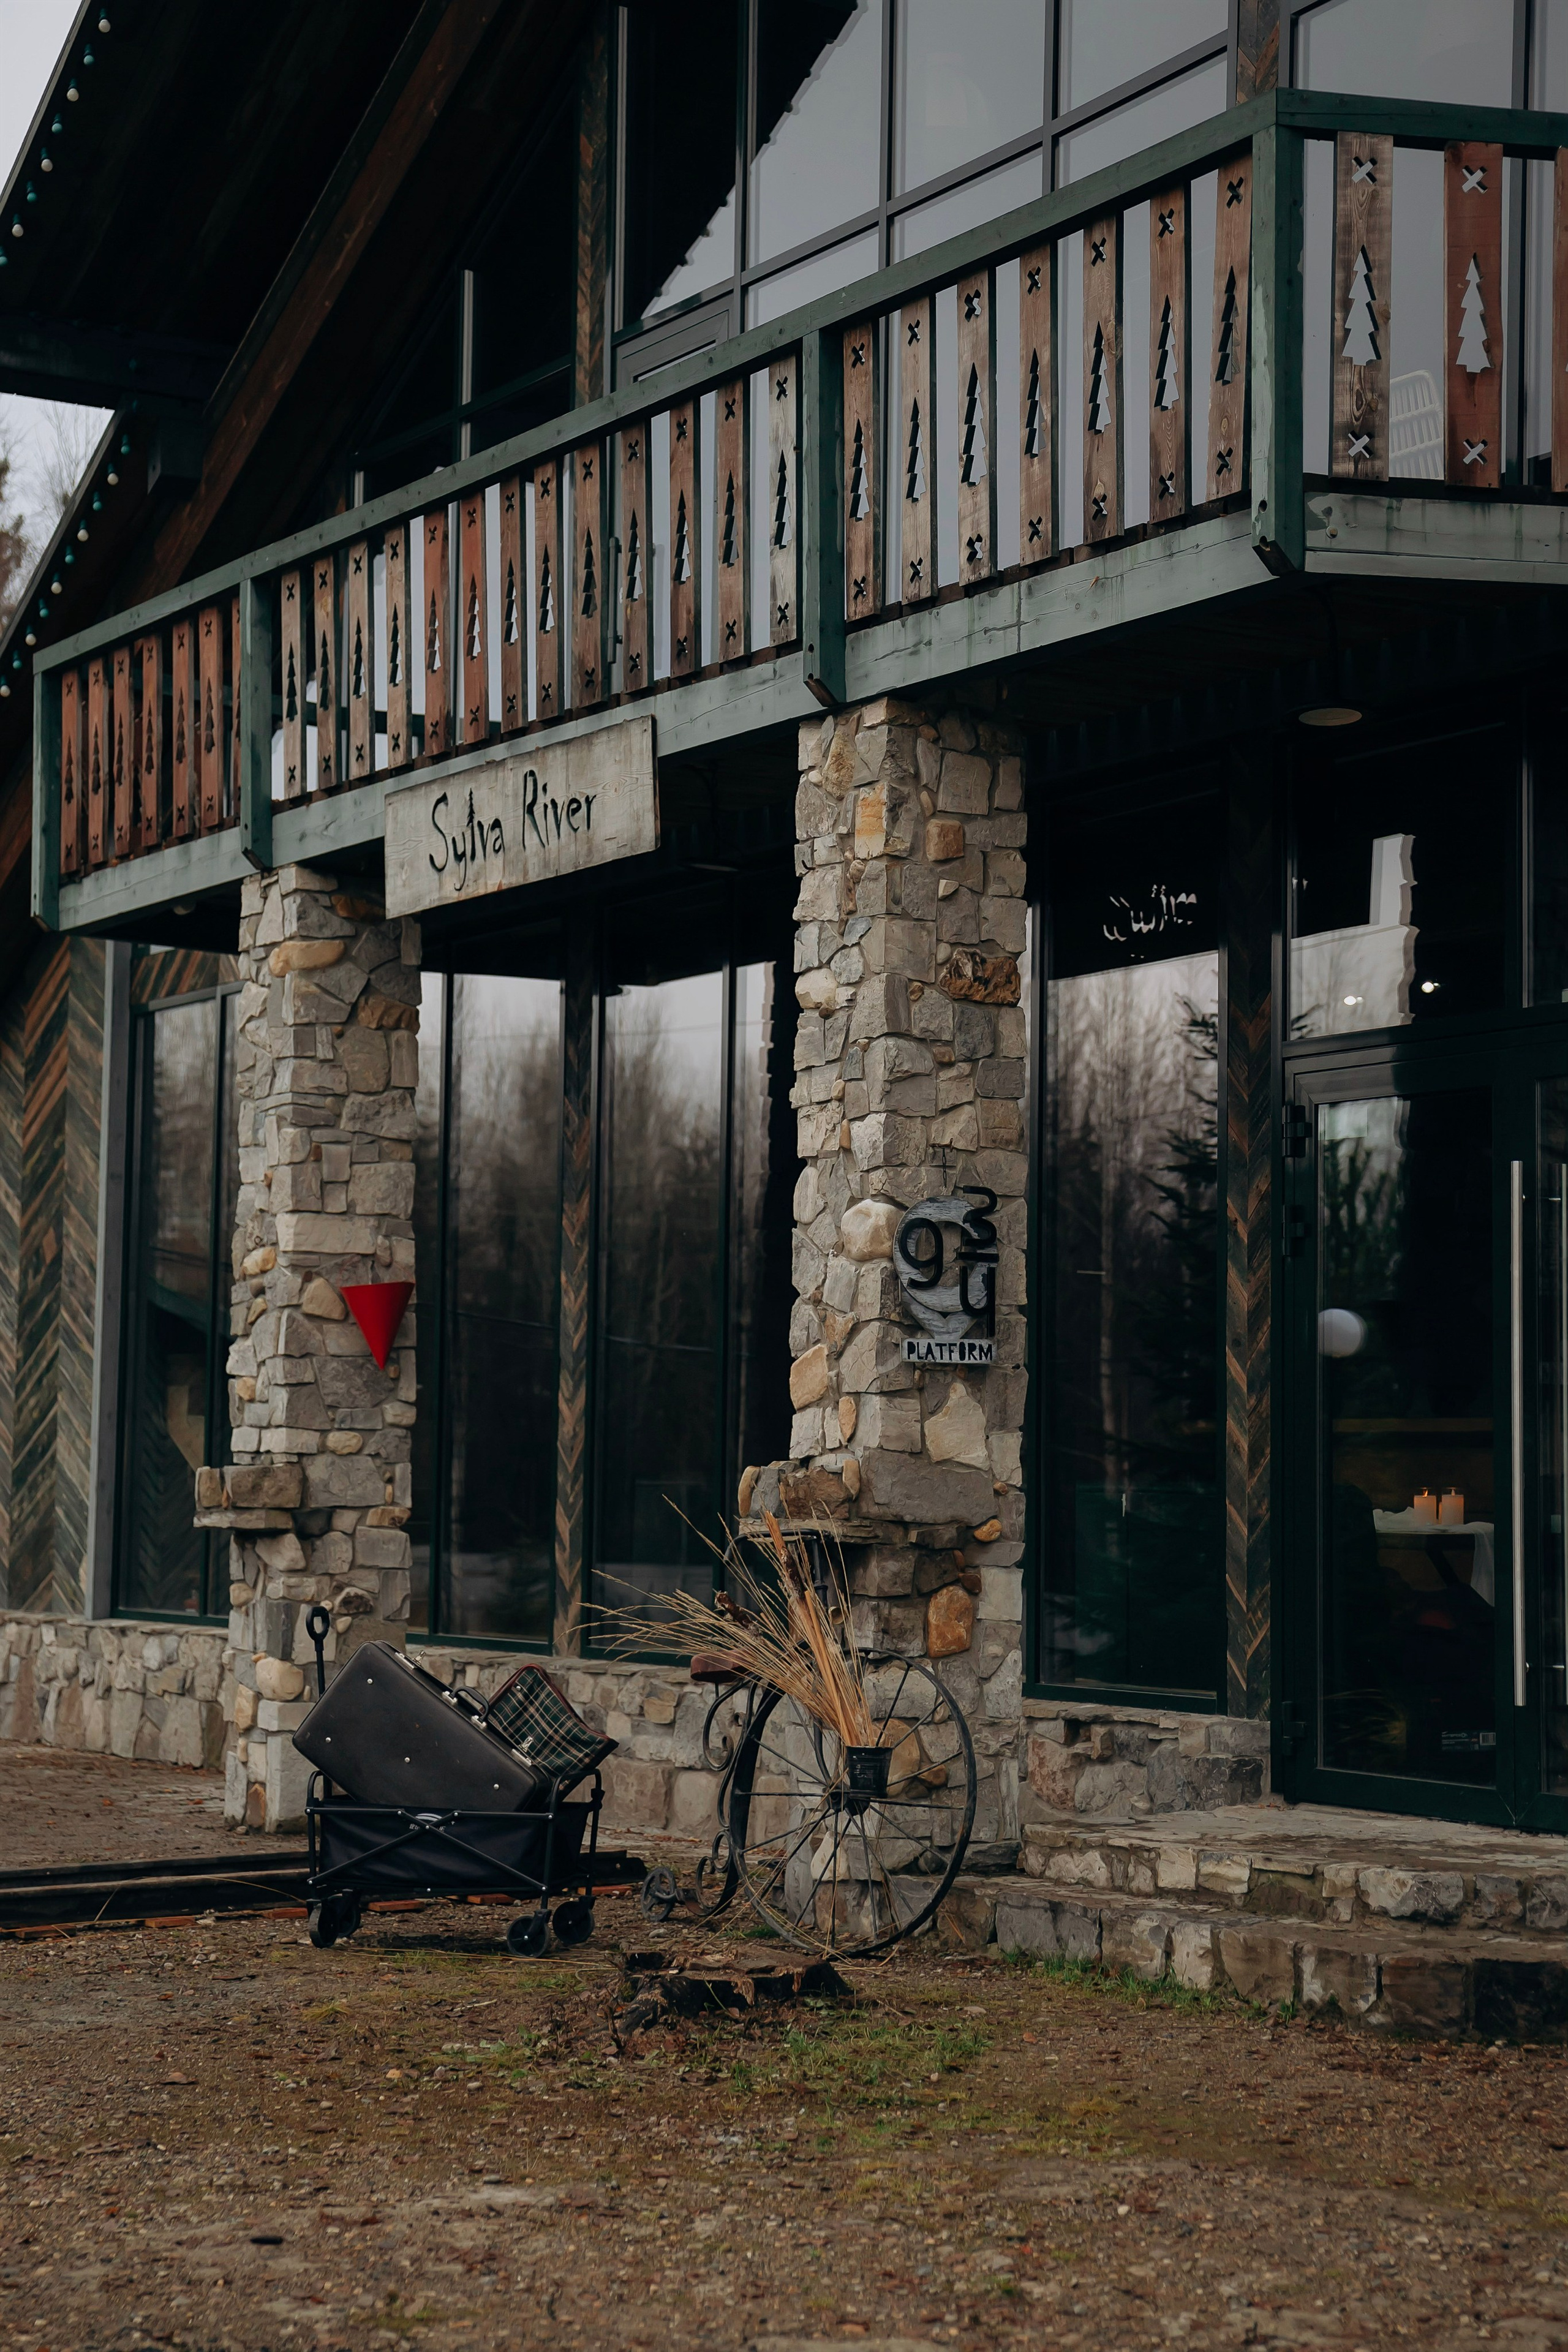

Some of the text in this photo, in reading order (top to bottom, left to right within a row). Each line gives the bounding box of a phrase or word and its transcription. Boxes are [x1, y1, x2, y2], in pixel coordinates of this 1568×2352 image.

[429, 769, 597, 891] Sylva River
[907, 1341, 993, 1361] PLATFORM
